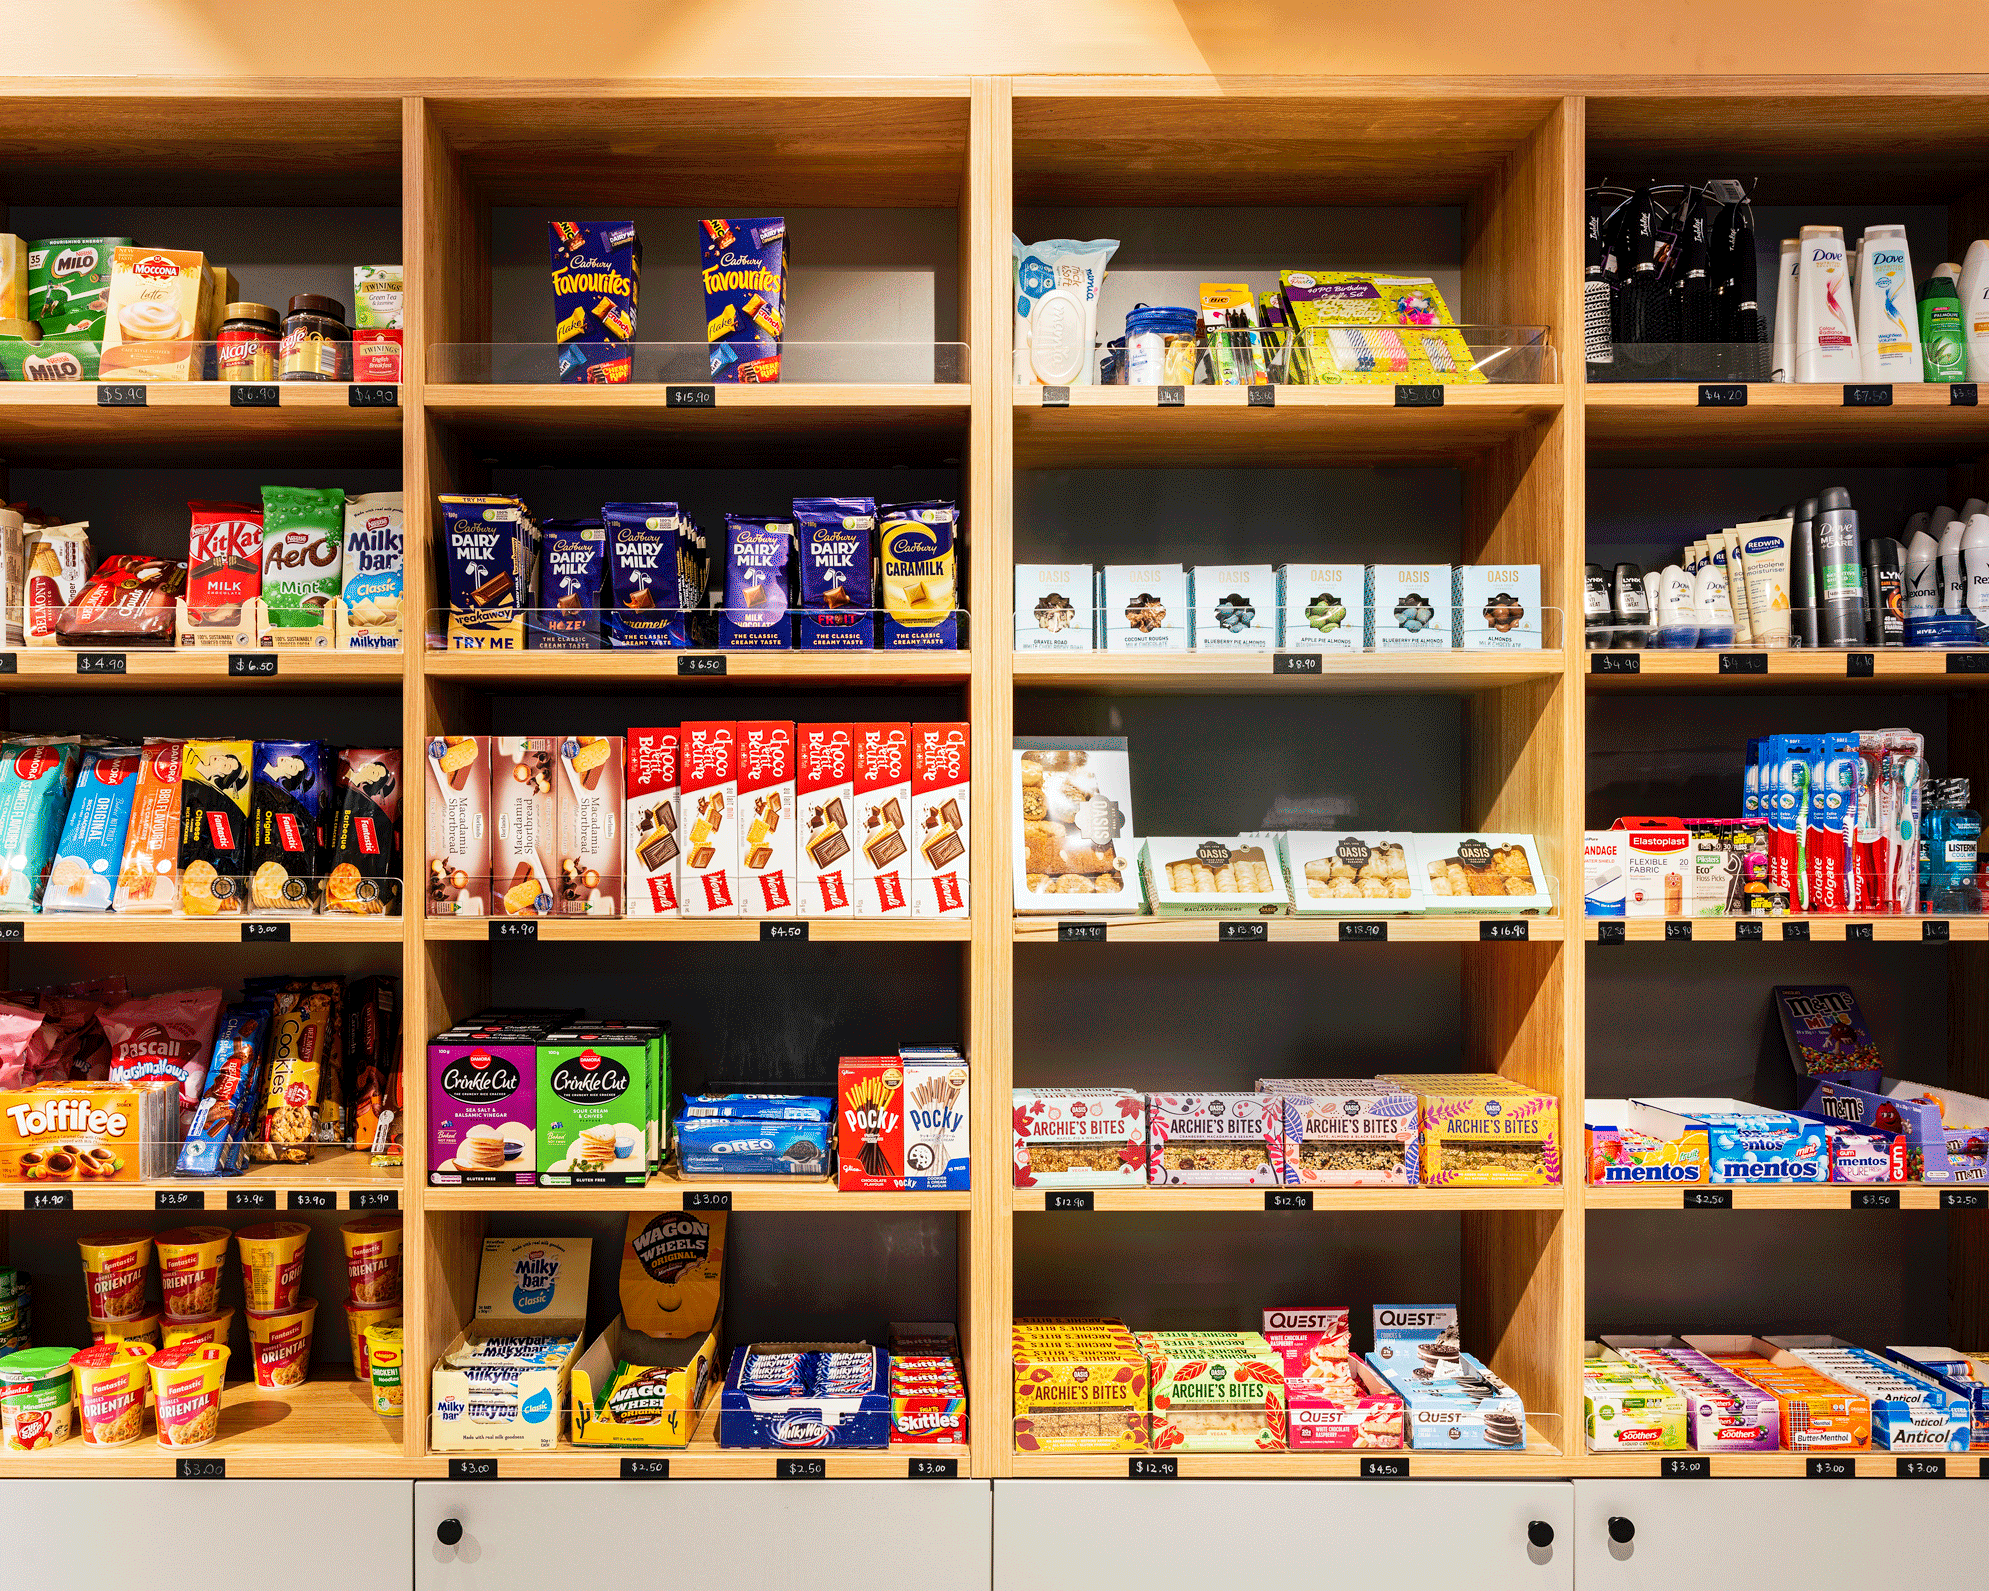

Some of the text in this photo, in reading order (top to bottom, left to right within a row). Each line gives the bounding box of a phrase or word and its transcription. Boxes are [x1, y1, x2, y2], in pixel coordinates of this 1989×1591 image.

[30, 255, 41, 265] 35
[570, 254, 612, 270] Cadbury
[720, 252, 762, 269] Cadbury
[1813, 248, 1843, 262] Dove
[1874, 252, 1904, 266] Dove
[57, 256, 94, 271] MILO
[135, 264, 177, 275] MOCCONA
[552, 266, 631, 297] Favourites
[702, 264, 781, 294] Favourites
[140, 288, 168, 300] Latte
[365, 282, 401, 292] TWININGS
[369, 293, 397, 301] Green Tea
[558, 319, 583, 339] flake
[708, 316, 732, 336] flake
[218, 342, 258, 364] Alcafé
[363, 345, 398, 354] TWININGS
[28, 362, 77, 380] MILO
[237, 387, 276, 403] $6.90
[355, 387, 393, 402] $4.90
[676, 391, 710, 404] $15.90
[1704, 389, 1742, 401] $4.20
[1853, 388, 1887, 402] $7.50
[1820, 522, 1853, 537] Dove
[197, 521, 262, 560] KitKat
[451, 533, 500, 547] DAIRY
[893, 538, 938, 555] Cadbury
[1748, 538, 1781, 549] REDWIN
[1820, 535, 1844, 545] MEN
[456, 546, 495, 560] MILK
[549, 551, 595, 564] DAIRY
[359, 553, 399, 574] bar
[885, 561, 945, 577] CARAMILK
[1748, 562, 1785, 571] sorbolene
[1310, 569, 1342, 583] OASIS
[1745, 568, 1785, 577] moisturiser
[207, 582, 243, 592] MILK
[281, 582, 319, 595] Mint
[357, 580, 396, 600] Classic
[36, 580, 48, 634] BELMONT
[349, 636, 400, 649] Milkybar
[80, 657, 125, 671] $4.90
[689, 659, 720, 670] $6.50
[1288, 658, 1316, 669] $8.90
[166, 744, 180, 783] DAMORA
[638, 735, 654, 785] Beurre
[661, 734, 678, 782] Choco
[88, 797, 111, 843] ORIGINAL
[193, 809, 204, 842] Cheese
[448, 798, 458, 854] Shortbread
[459, 797, 468, 855] Macadamia
[514, 797, 523, 855] Macadamia
[524, 798, 533, 854] Shortbread
[214, 813, 228, 848] Fantastic
[264, 810, 273, 845] Original
[1633, 836, 1686, 847] Elastoplast
[1199, 848, 1229, 859] OASIS
[1585, 845, 1618, 856] ANDAGE
[1629, 858, 1668, 866] FLEXIBLE
[1679, 858, 1689, 866] 20
[1629, 866, 1660, 874] FABRIC
[1696, 866, 1710, 875] Eco
[1696, 875, 1726, 883] Floss Picks
[1824, 858, 1834, 908] Colgate
[249, 924, 277, 935] $3.00
[500, 924, 535, 935] $4.90
[771, 926, 801, 937] $4.50
[1067, 926, 1101, 937] $29.90
[1345, 925, 1380, 935] $18.90
[1490, 925, 1525, 936] $16.90
[119, 1040, 180, 1061] Pascall
[305, 1026, 315, 1061] BELMONT
[271, 1018, 300, 1096] Cookies
[438, 1048, 450, 1056] 100g
[580, 1056, 601, 1064] DAMORA
[444, 1068, 518, 1091] Crinkle Cut
[7, 1099, 128, 1137] Toffifee
[844, 1107, 896, 1133] POCKY
[1033, 1120, 1124, 1136] ARCHIE'S BITES
[710, 1139, 774, 1155] OREO
[1838, 1157, 1888, 1166] mentos
[34, 1195, 64, 1207] $4.90
[297, 1194, 326, 1206] $3.90
[692, 1194, 728, 1206] $3.00
[1055, 1197, 1085, 1208] $12.90
[1695, 1194, 1723, 1205] $2.50
[1862, 1195, 1889, 1205] $3.50
[631, 1222, 708, 1250] WAGON
[638, 1239, 708, 1263] WHEELS
[652, 1251, 696, 1265] ORIGINAL
[515, 1259, 557, 1279] Milky
[95, 1271, 142, 1290] ORIENTAL
[521, 1275, 549, 1288] bar
[1380, 1311, 1438, 1326] QUEST
[93, 1379, 126, 1394] Fantastic
[1033, 1386, 1127, 1400] ARCHIE'S BITES
[1171, 1384, 1264, 1398] ARCHIE'S BITES
[1885, 1393, 1922, 1404] Anticol
[443, 1411, 460, 1421] bar
[898, 1413, 959, 1432] Skittles
[1299, 1411, 1343, 1423] QUEST
[1419, 1411, 1462, 1423] QUEST
[1722, 1428, 1758, 1439] Soothers
[1894, 1429, 1950, 1443] Anticol
[631, 1462, 662, 1473] $2.50
[790, 1463, 823, 1474] $2.50
[917, 1463, 947, 1473] $3.00
[1136, 1461, 1177, 1474] $12.90
[1369, 1463, 1398, 1475] $4.50
[1908, 1463, 1940, 1473] $3.00
